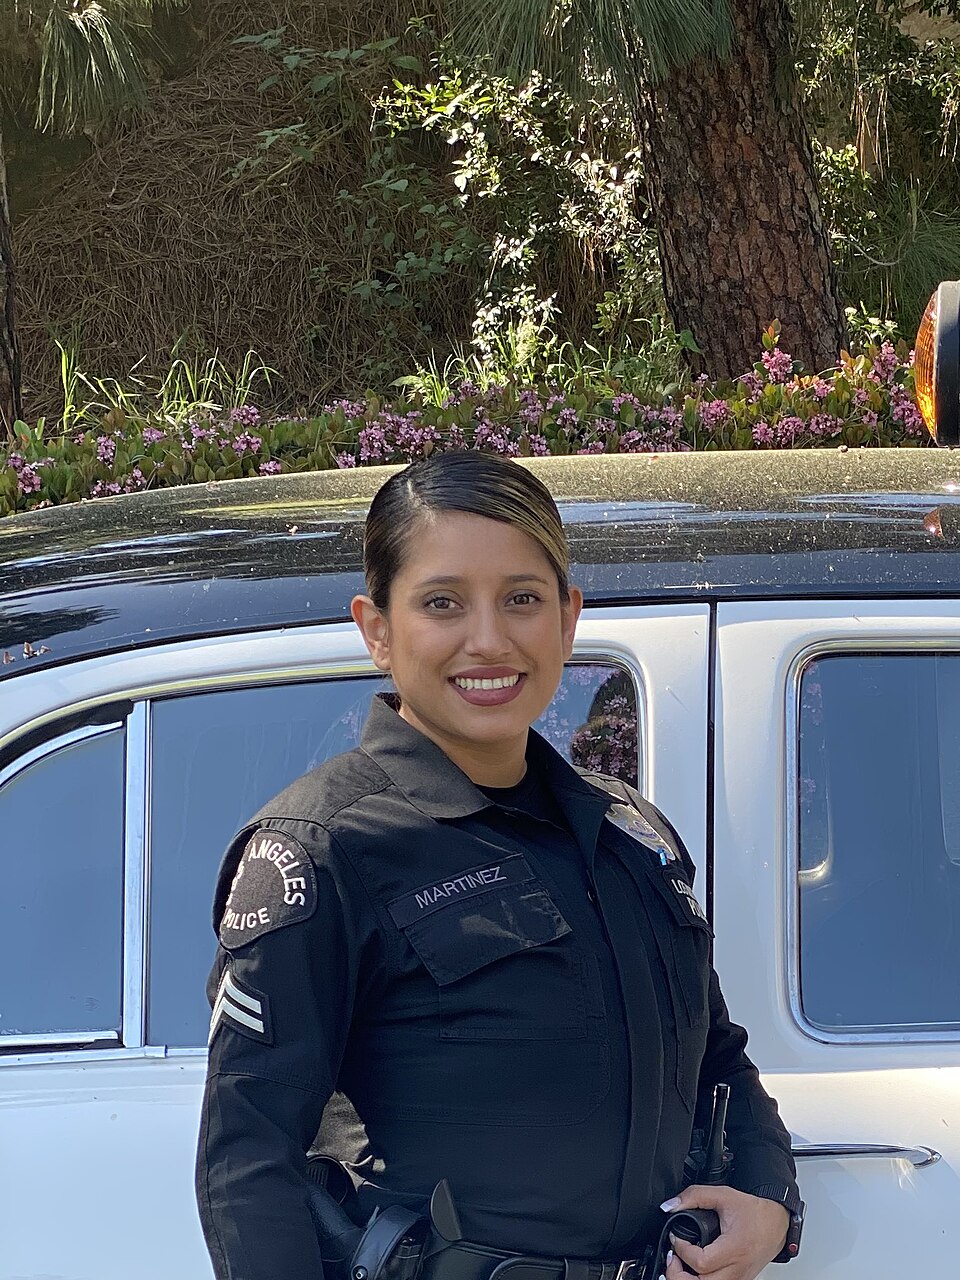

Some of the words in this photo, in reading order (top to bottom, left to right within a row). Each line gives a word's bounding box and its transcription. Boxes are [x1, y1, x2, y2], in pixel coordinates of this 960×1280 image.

[248, 839, 306, 907] ANGELES
[414, 866, 508, 909] MARTINEZ
[223, 907, 270, 931] POLICE
